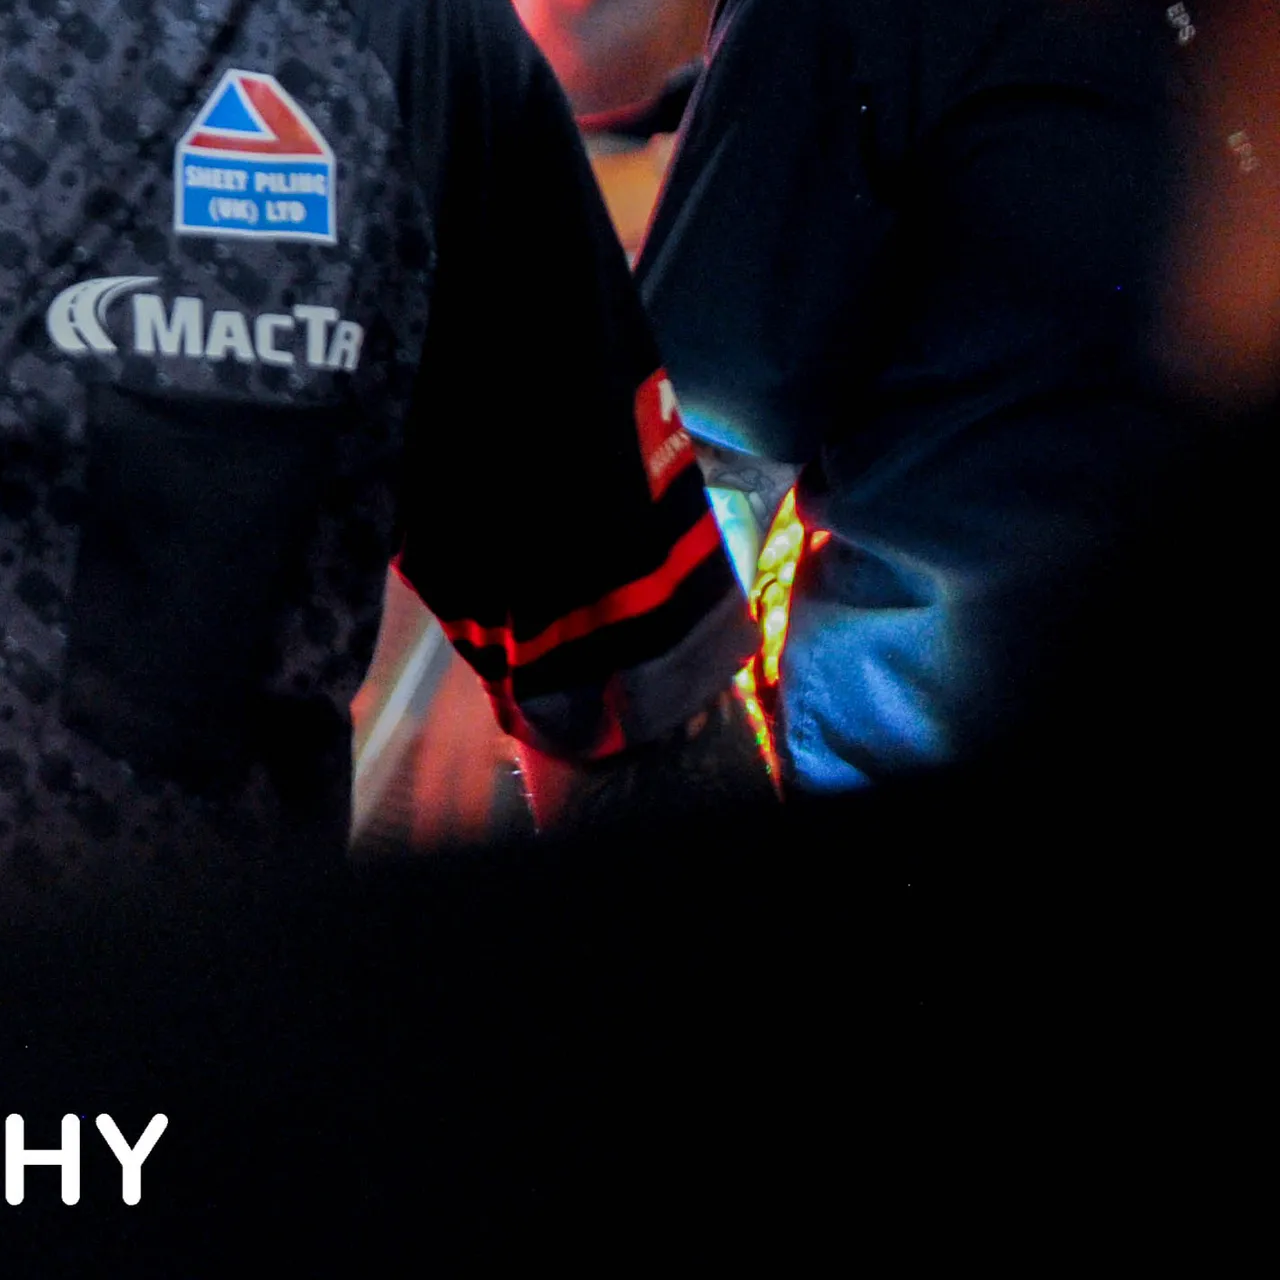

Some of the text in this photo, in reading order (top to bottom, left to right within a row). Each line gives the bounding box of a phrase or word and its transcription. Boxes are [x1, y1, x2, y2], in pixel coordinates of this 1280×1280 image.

[185, 165, 327, 195] SHEET PILING
[208, 196, 307, 224] (UK) LTD
